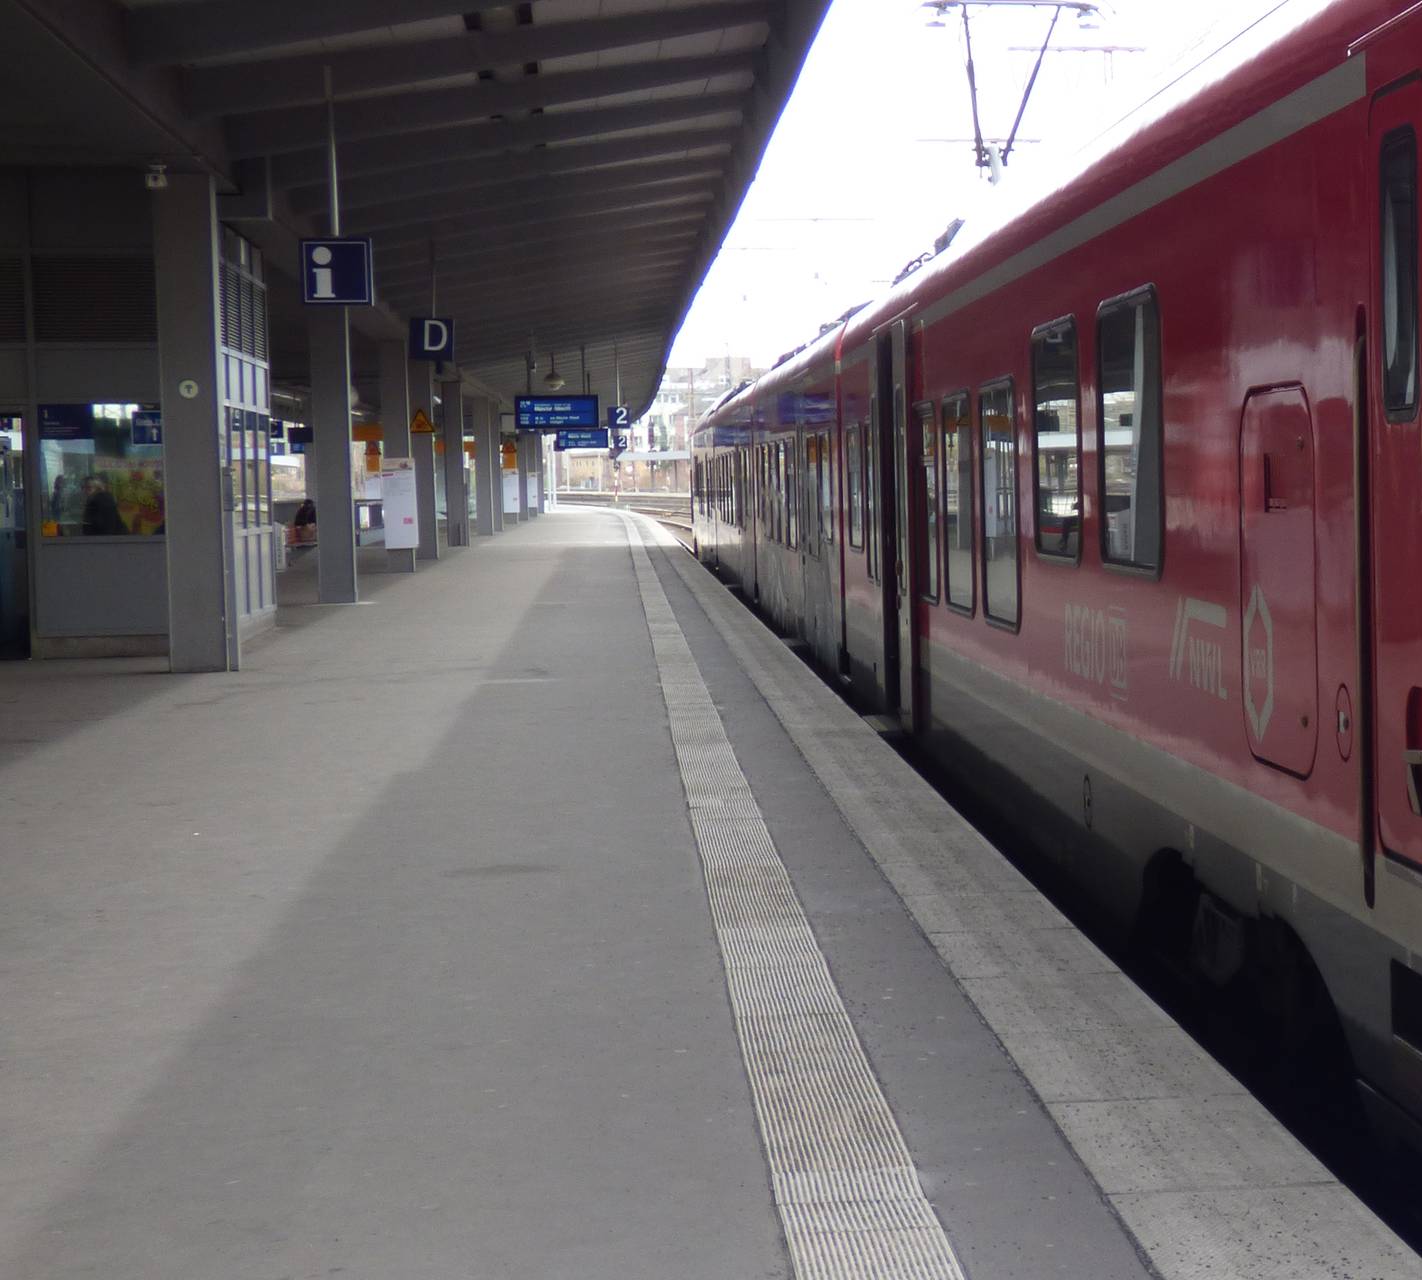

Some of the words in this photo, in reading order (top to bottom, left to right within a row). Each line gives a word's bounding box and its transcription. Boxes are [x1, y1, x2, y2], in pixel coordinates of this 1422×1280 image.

[311, 246, 337, 298] i
[424, 319, 448, 351] D
[615, 407, 628, 425] 2
[618, 436, 627, 448] 2
[1064, 602, 1106, 685] REGIO
